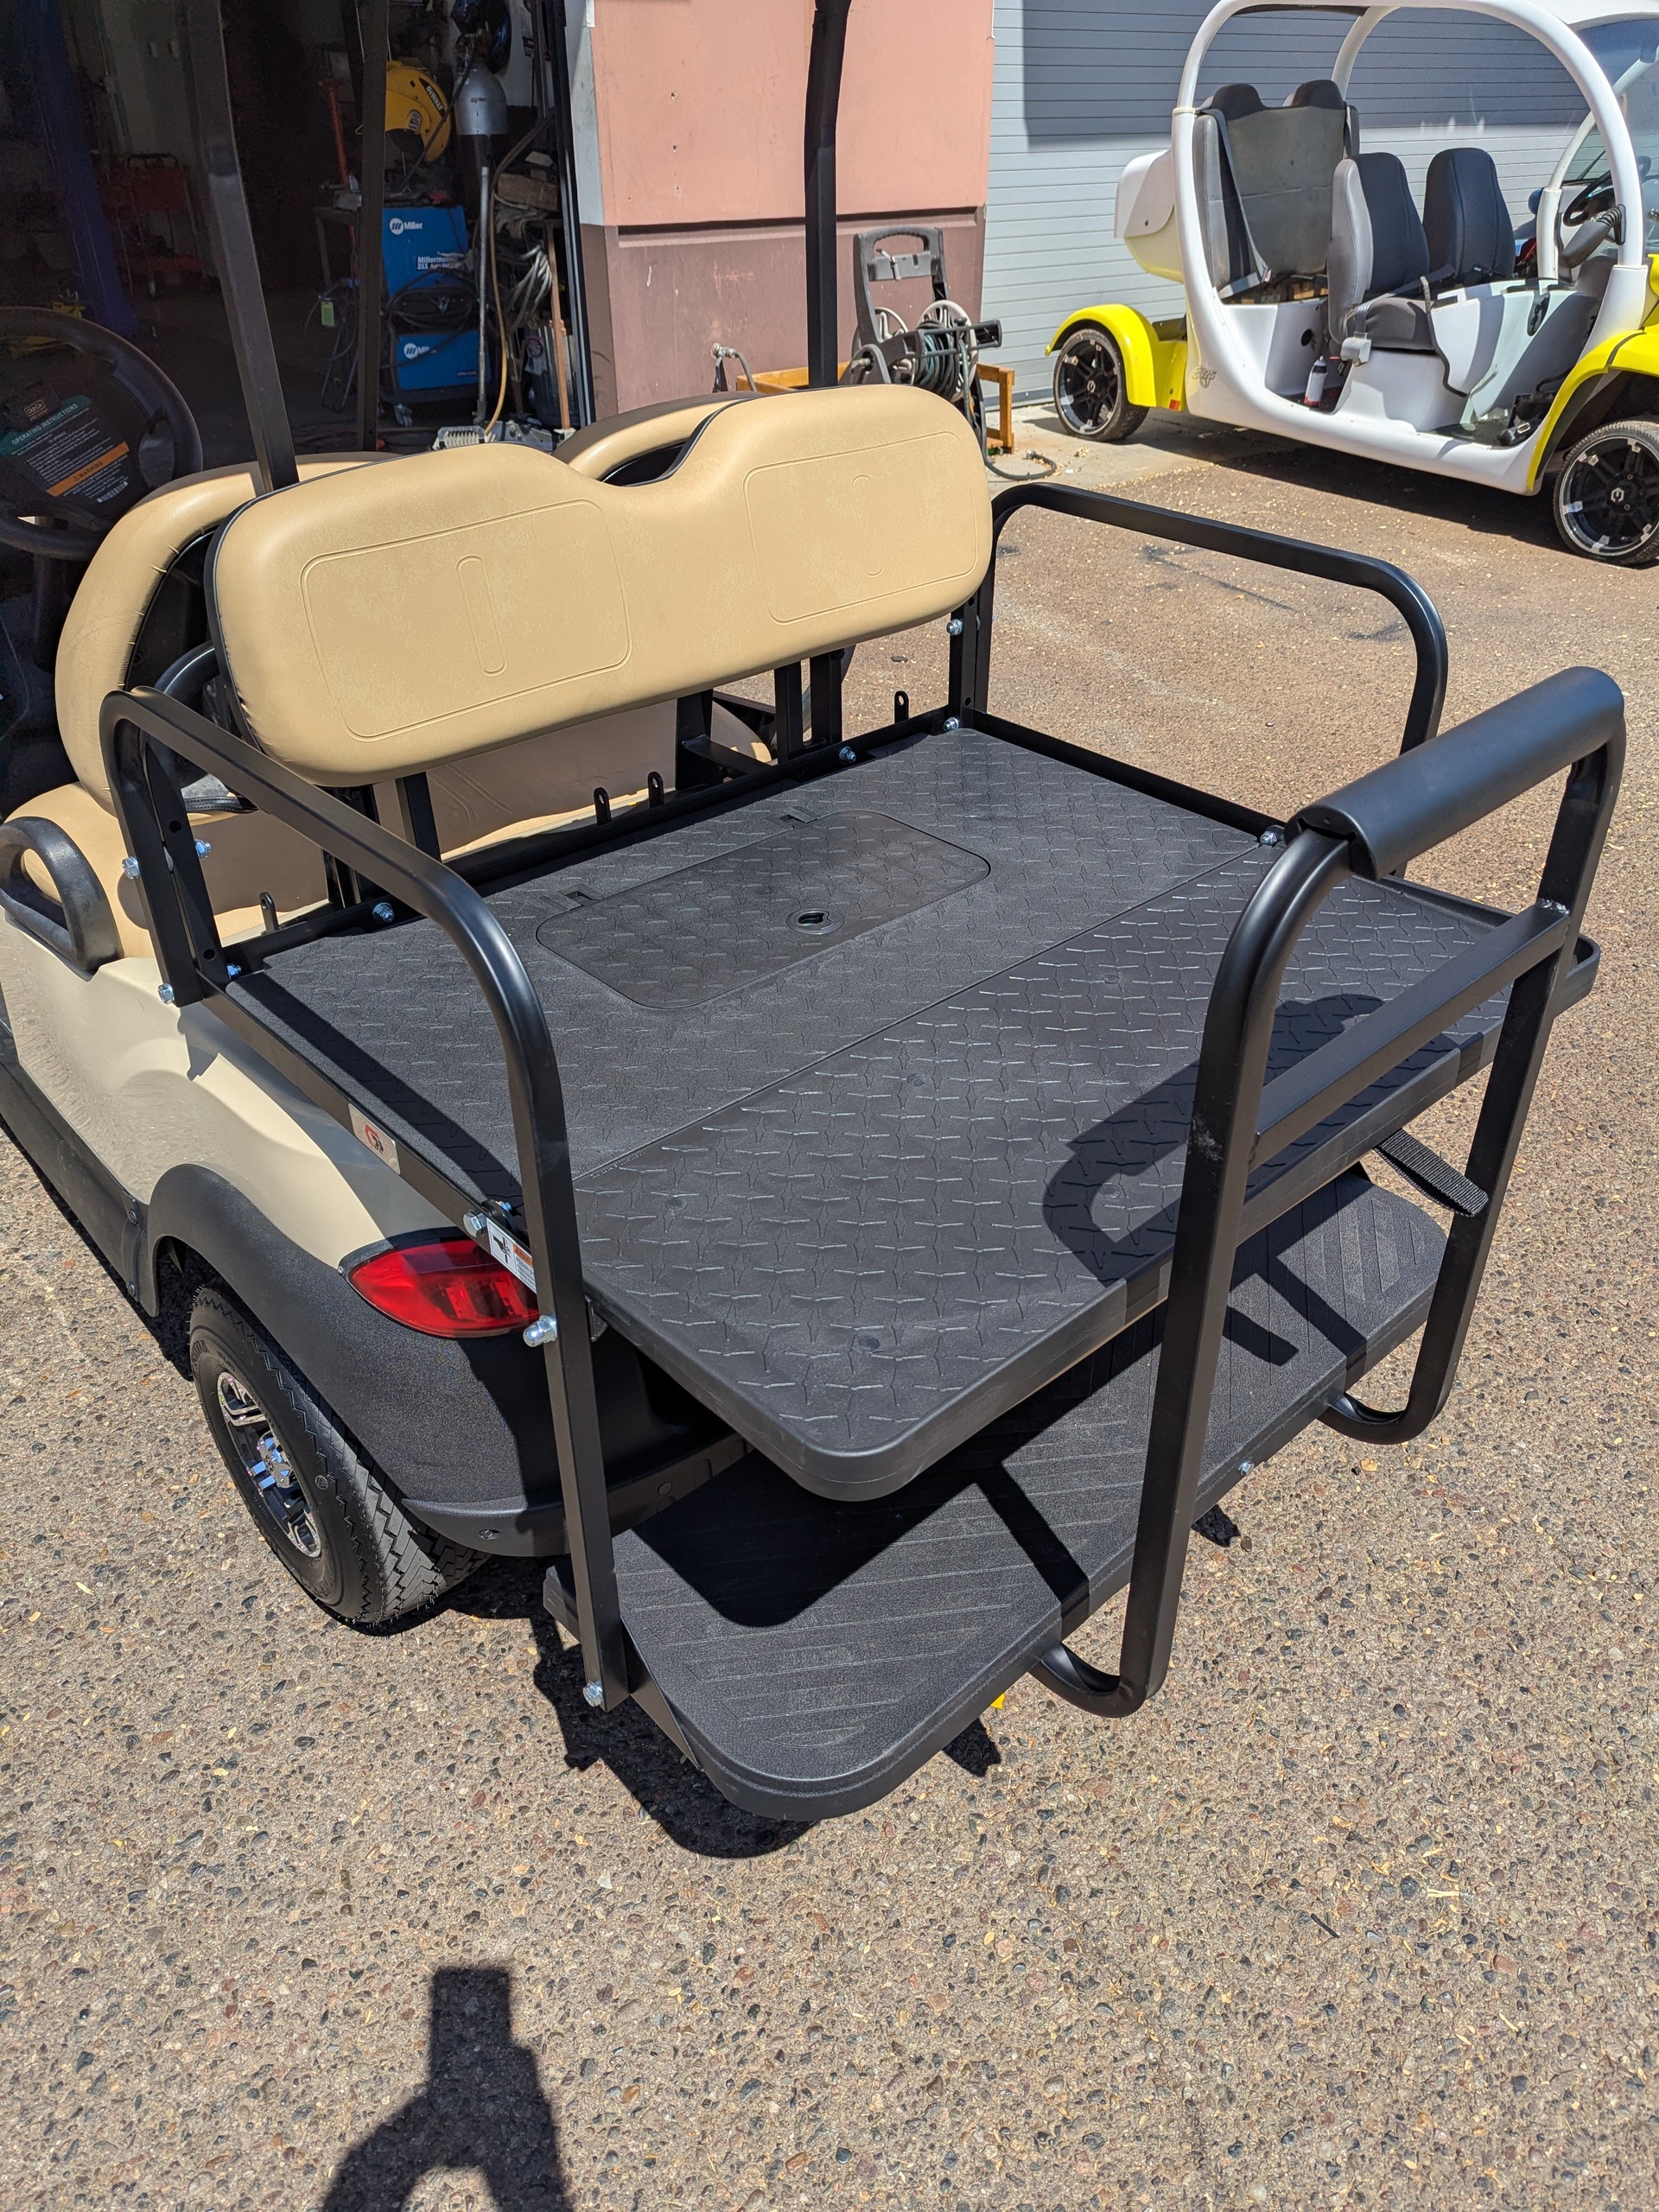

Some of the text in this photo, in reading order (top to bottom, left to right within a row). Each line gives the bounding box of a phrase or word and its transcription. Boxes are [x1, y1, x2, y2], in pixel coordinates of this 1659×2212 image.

[404, 221, 423, 230] Miller
[417, 346, 437, 355] Mill
[11, 425, 41, 445] OPERATING
[41, 403, 79, 428] INSTRUCTIONS
[79, 461, 104, 479] WARNING
